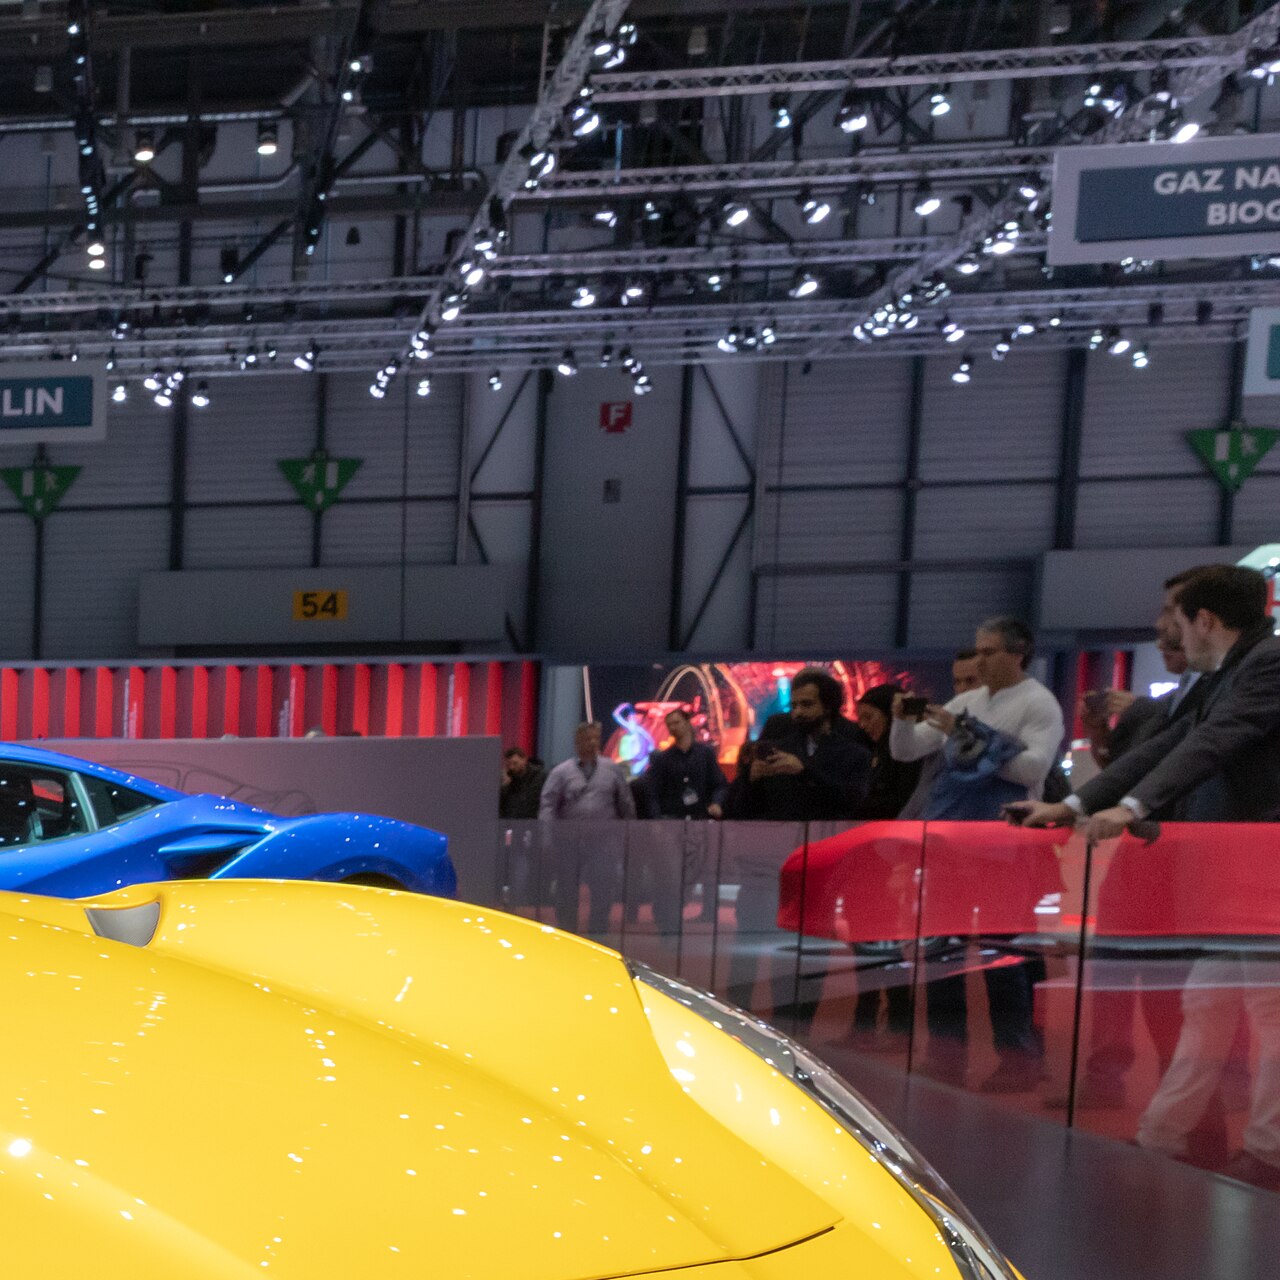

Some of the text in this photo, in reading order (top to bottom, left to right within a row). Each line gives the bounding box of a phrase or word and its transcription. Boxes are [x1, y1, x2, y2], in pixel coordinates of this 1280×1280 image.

[1154, 165, 1280, 195] GAZ NA
[1206, 200, 1280, 226] BIOG
[610, 404, 625, 425] F
[302, 592, 338, 618] 54
